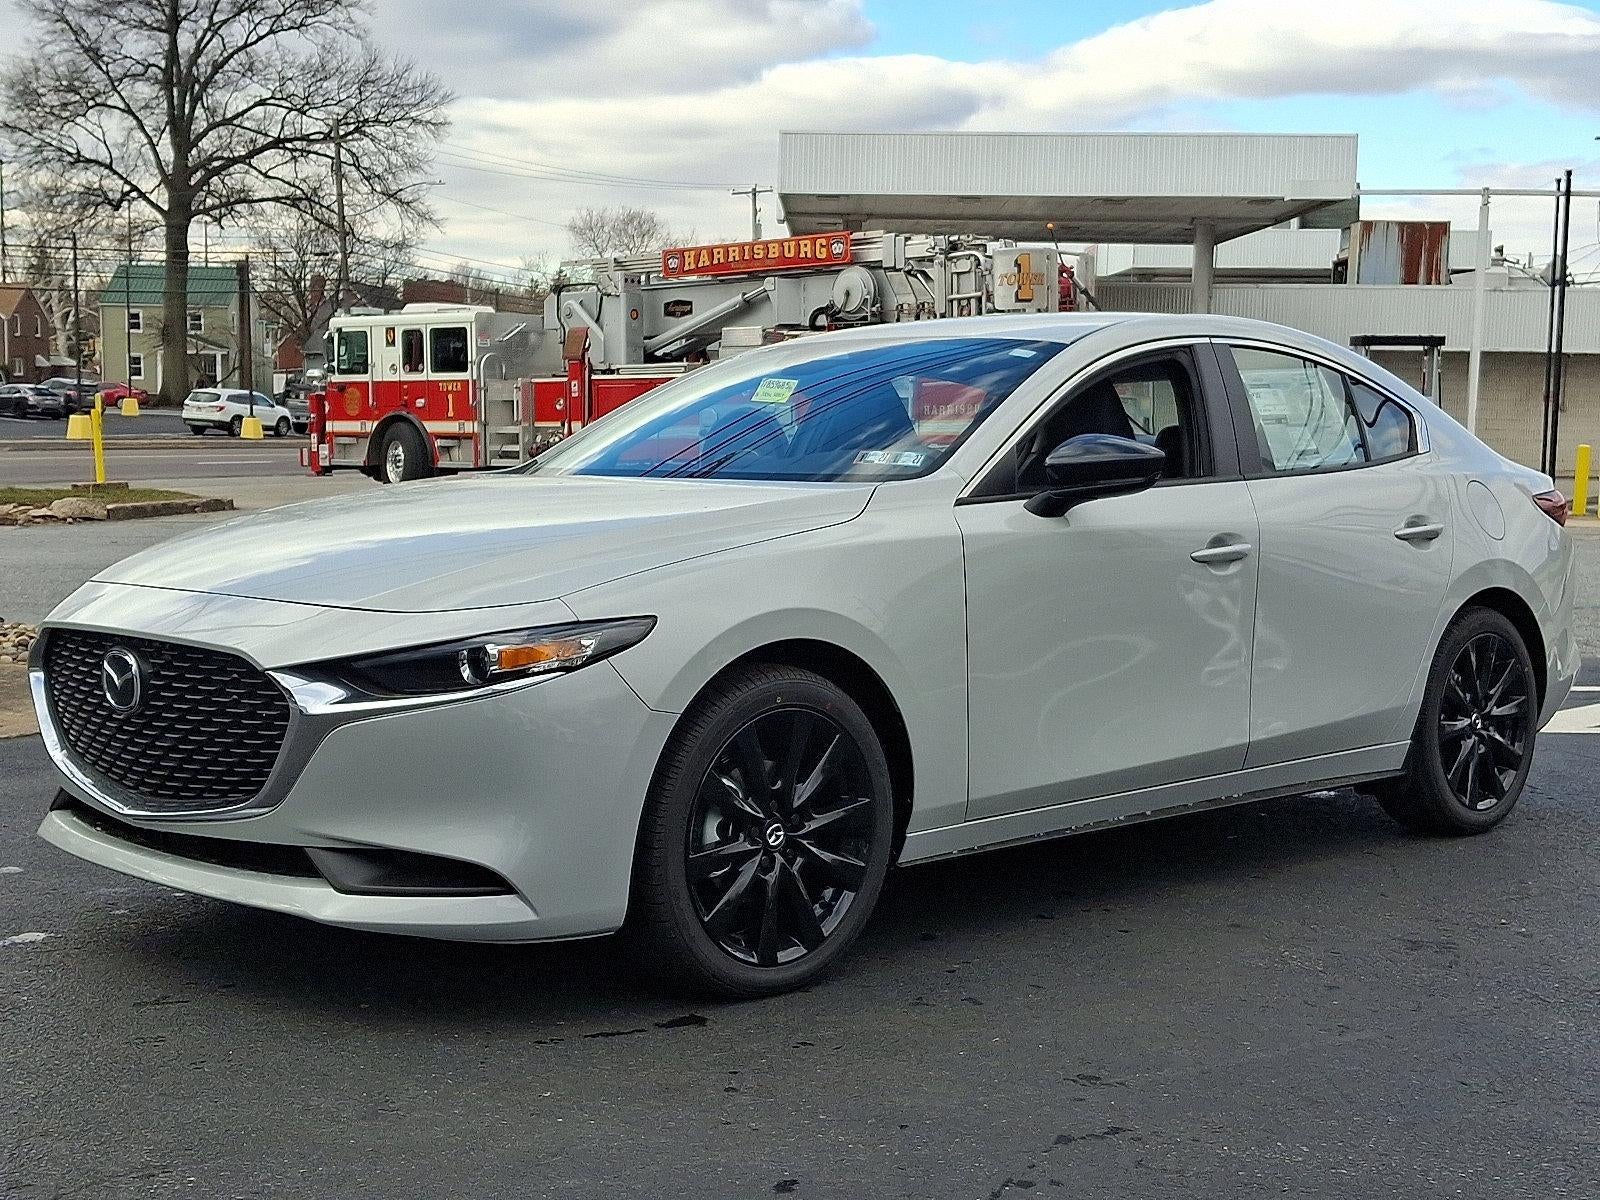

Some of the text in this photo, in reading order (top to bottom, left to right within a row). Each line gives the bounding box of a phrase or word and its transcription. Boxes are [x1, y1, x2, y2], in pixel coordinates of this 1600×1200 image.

[683, 238, 828, 272] HARRISBURG
[1013, 252, 1033, 303] 1
[438, 382, 462, 392] TOWER
[447, 393, 454, 418] 1
